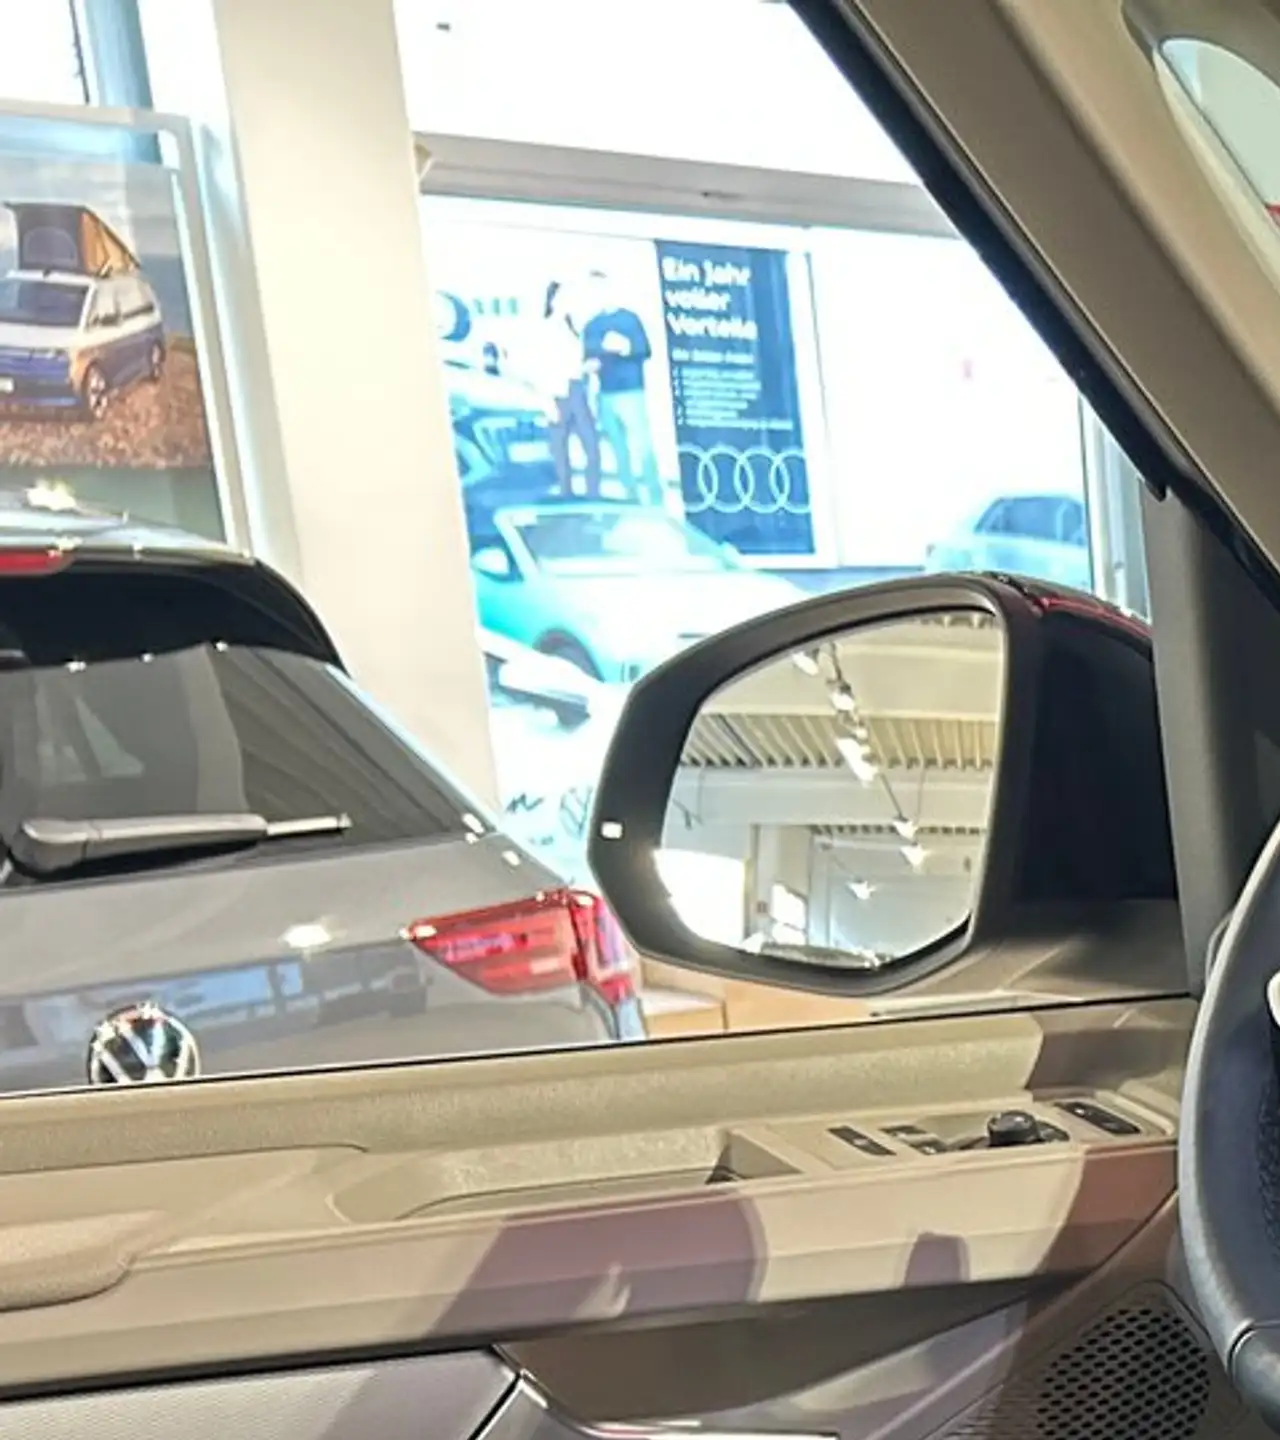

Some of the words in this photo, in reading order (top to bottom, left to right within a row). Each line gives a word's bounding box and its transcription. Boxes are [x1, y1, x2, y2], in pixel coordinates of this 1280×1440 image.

[662, 256, 700, 282] Ein
[703, 259, 752, 287] Jahr
[665, 287, 731, 311] voller
[667, 312, 758, 340] Vorteile
